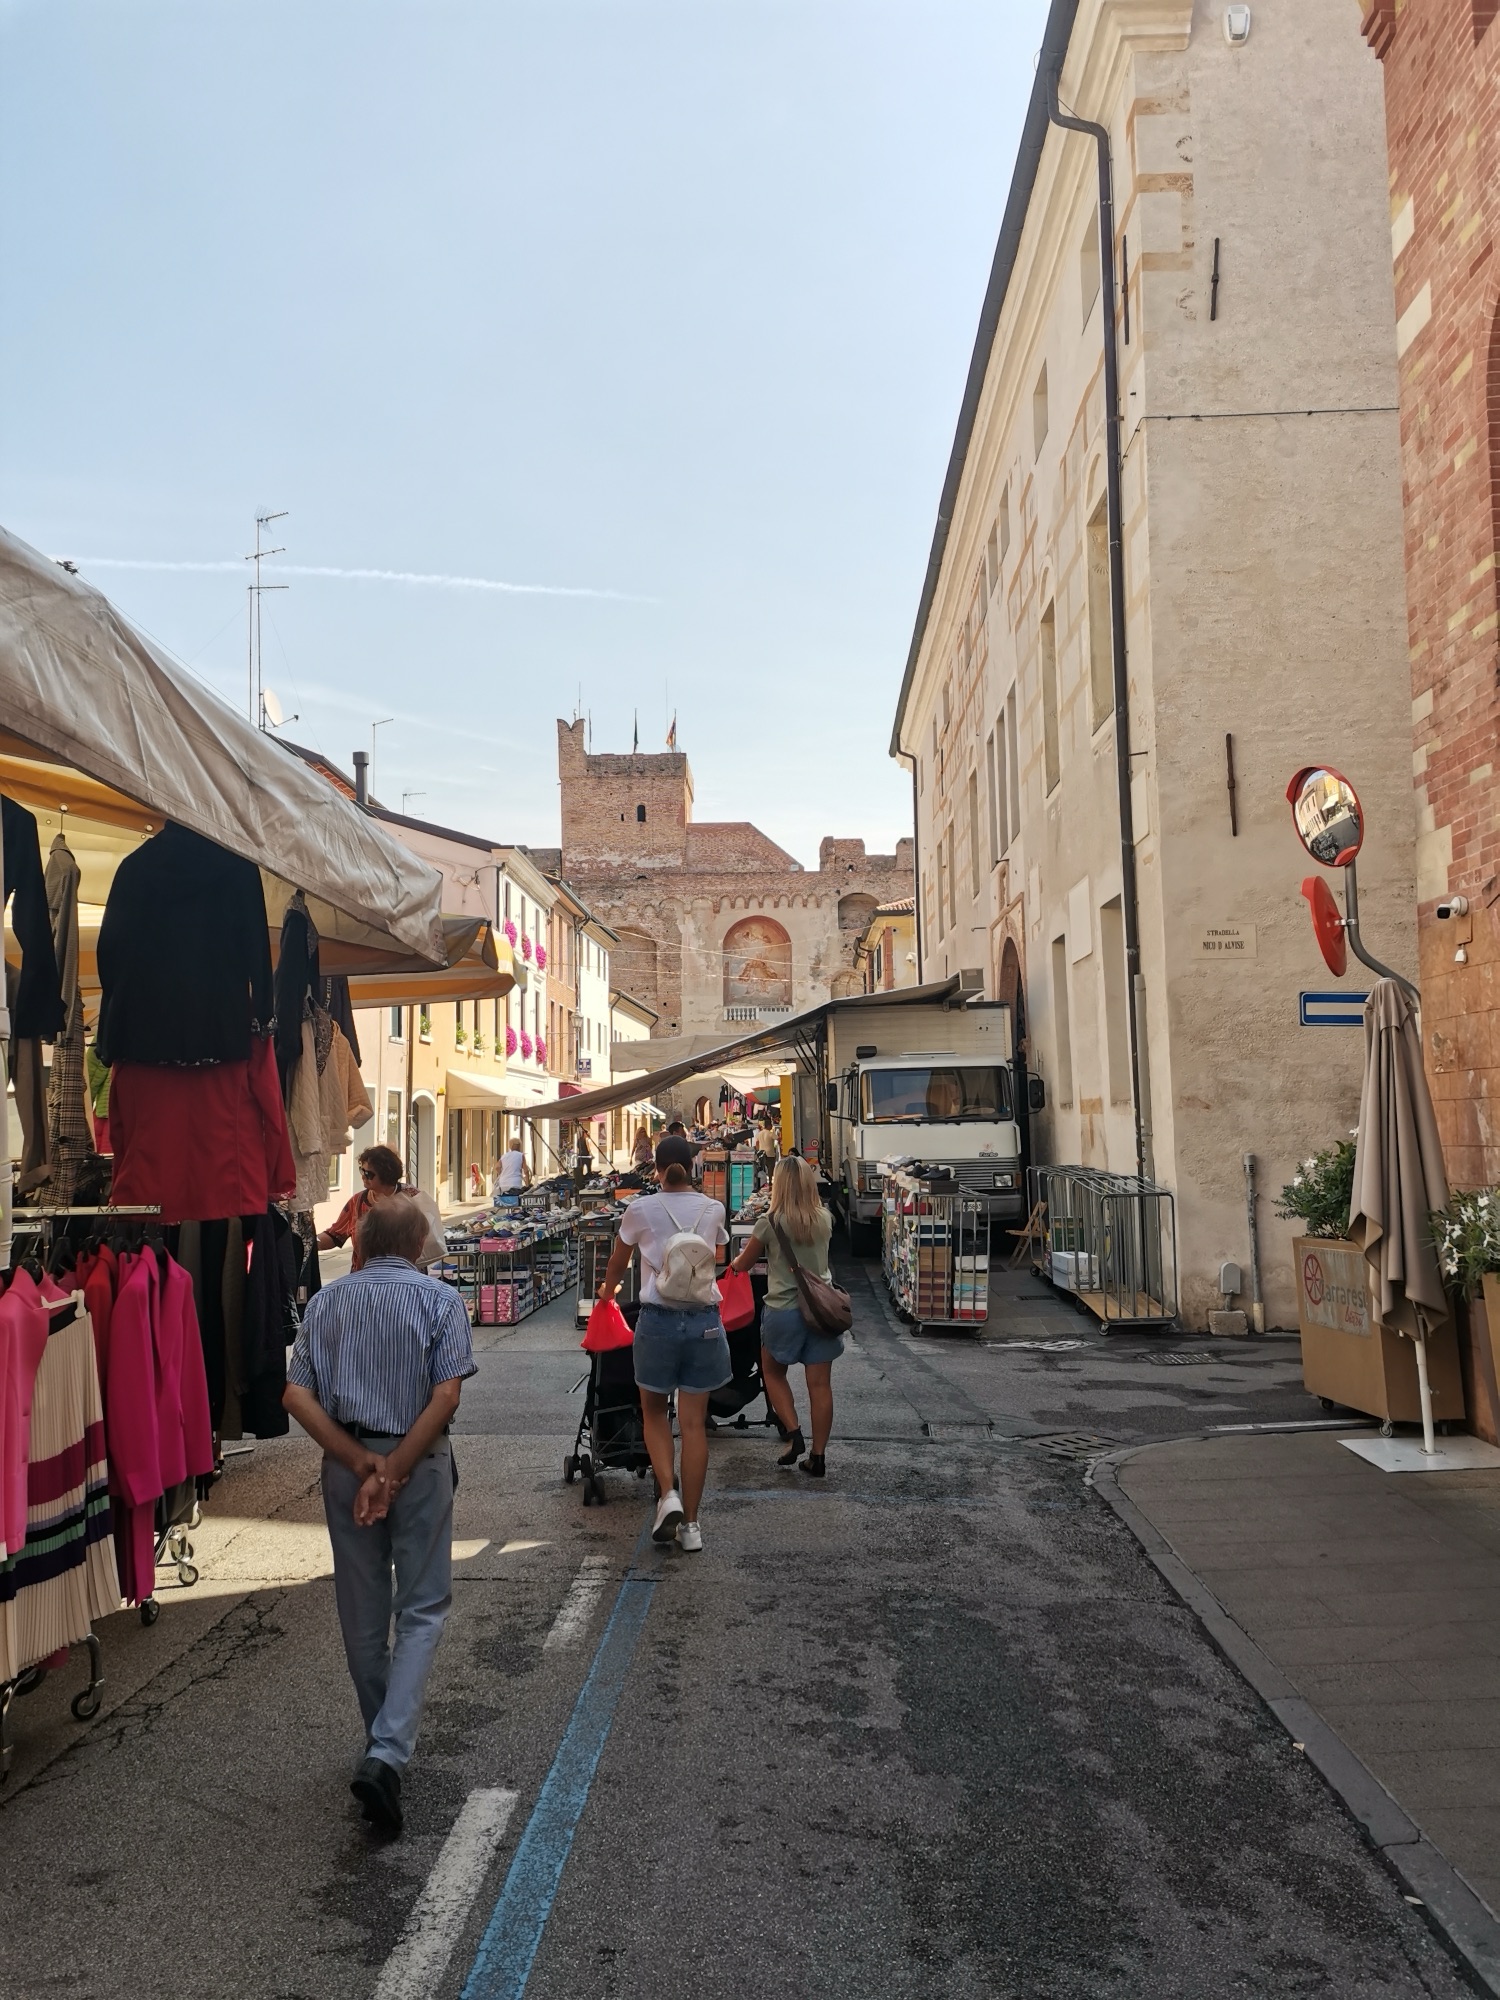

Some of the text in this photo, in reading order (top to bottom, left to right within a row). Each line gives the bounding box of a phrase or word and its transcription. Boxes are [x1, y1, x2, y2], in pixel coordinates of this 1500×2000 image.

[1202, 941, 1216, 950] NICO
[521, 1197, 546, 1206] EVERLAST
[1319, 1279, 1367, 1309] Carraresi
